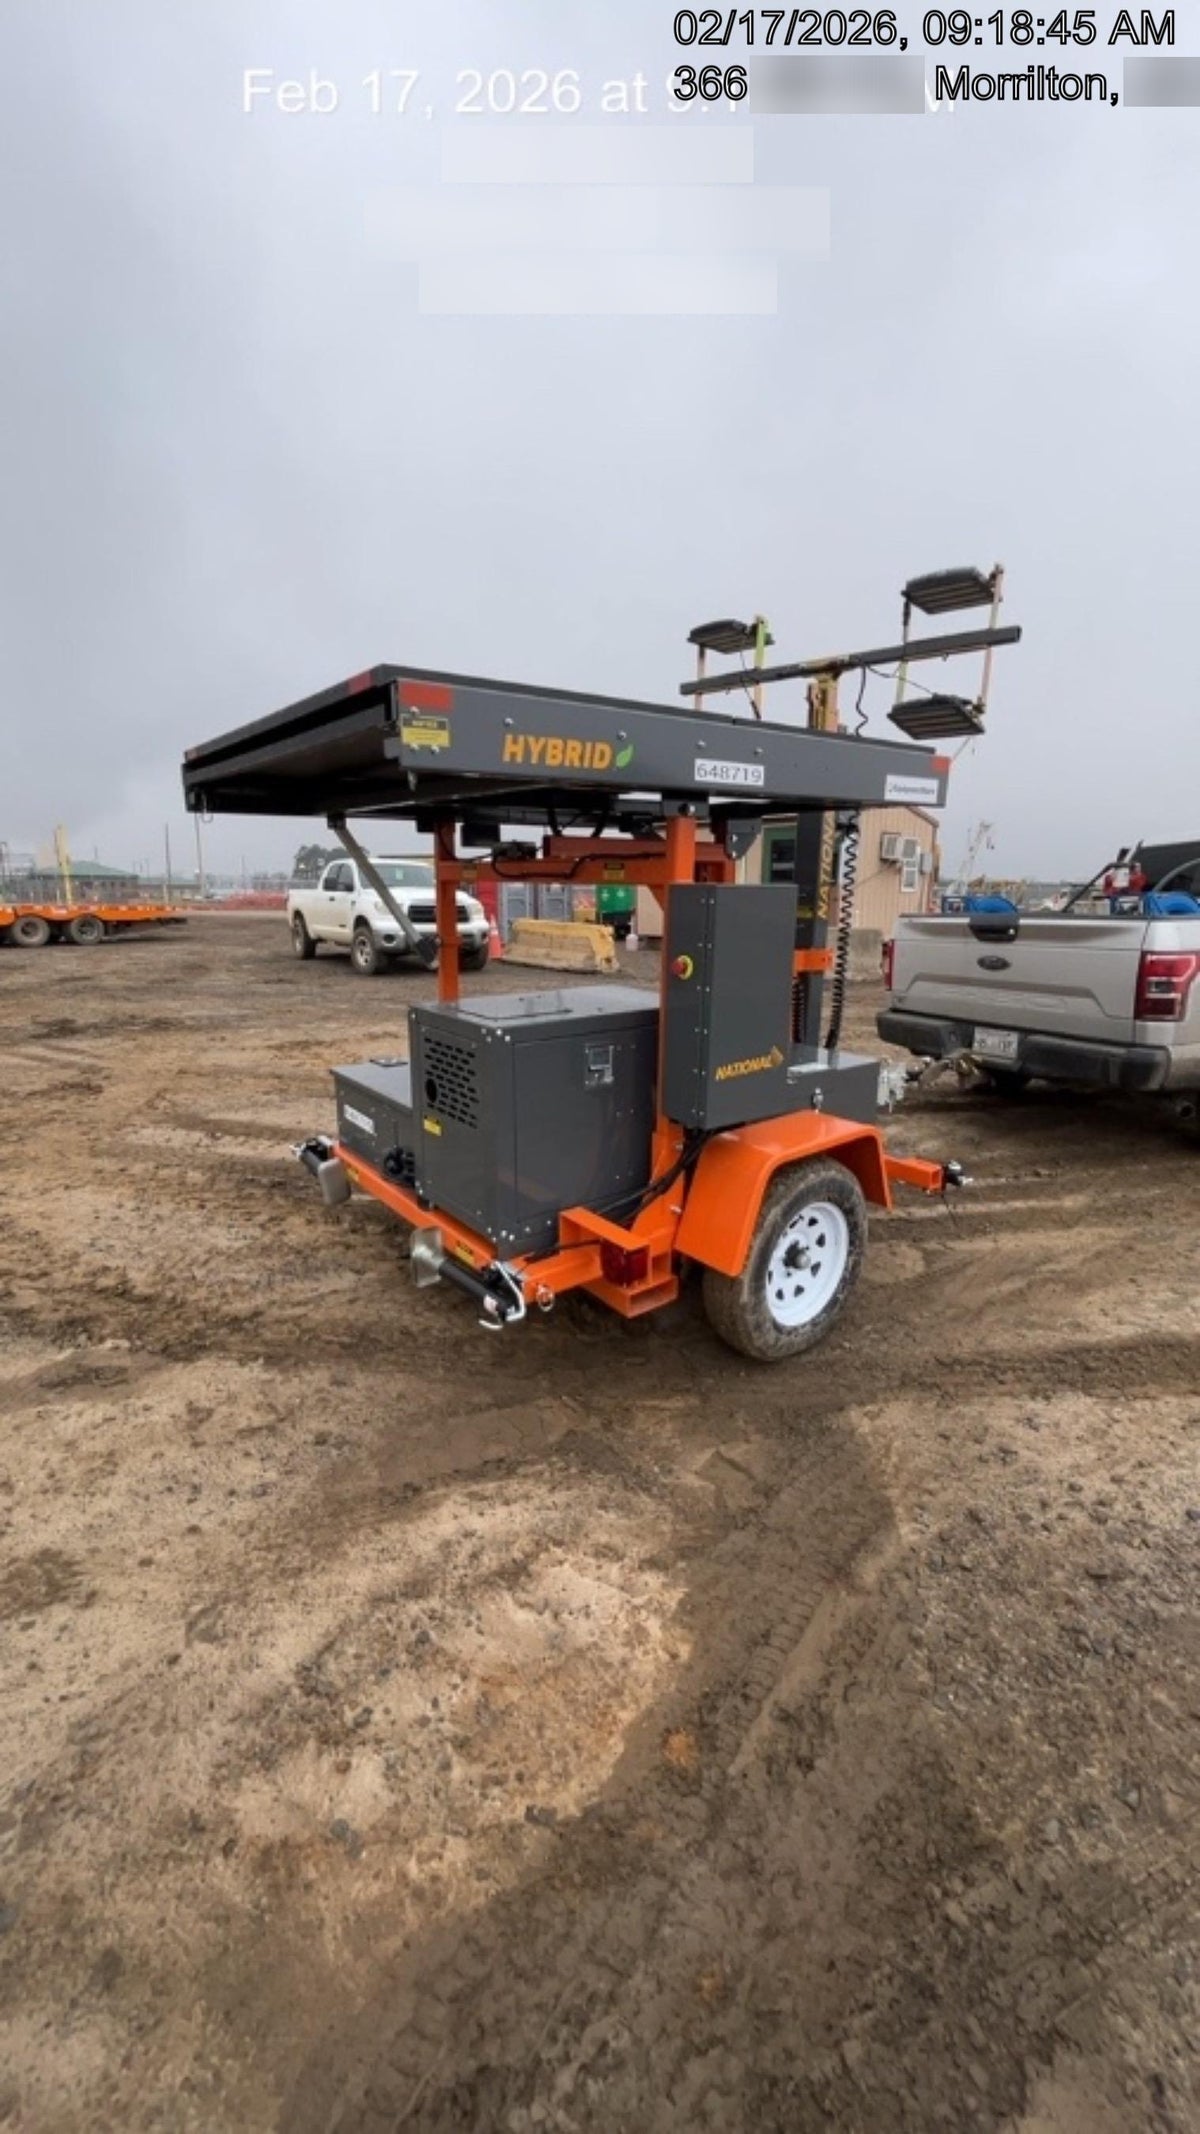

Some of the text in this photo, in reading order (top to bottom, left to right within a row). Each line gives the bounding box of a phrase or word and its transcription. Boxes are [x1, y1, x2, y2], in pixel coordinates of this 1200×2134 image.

[502, 734, 613, 770] HYBRID
[696, 763, 762, 783] 648719
[816, 810, 837, 919] NATIONA
[715, 1055, 772, 1082] NATIONAL
